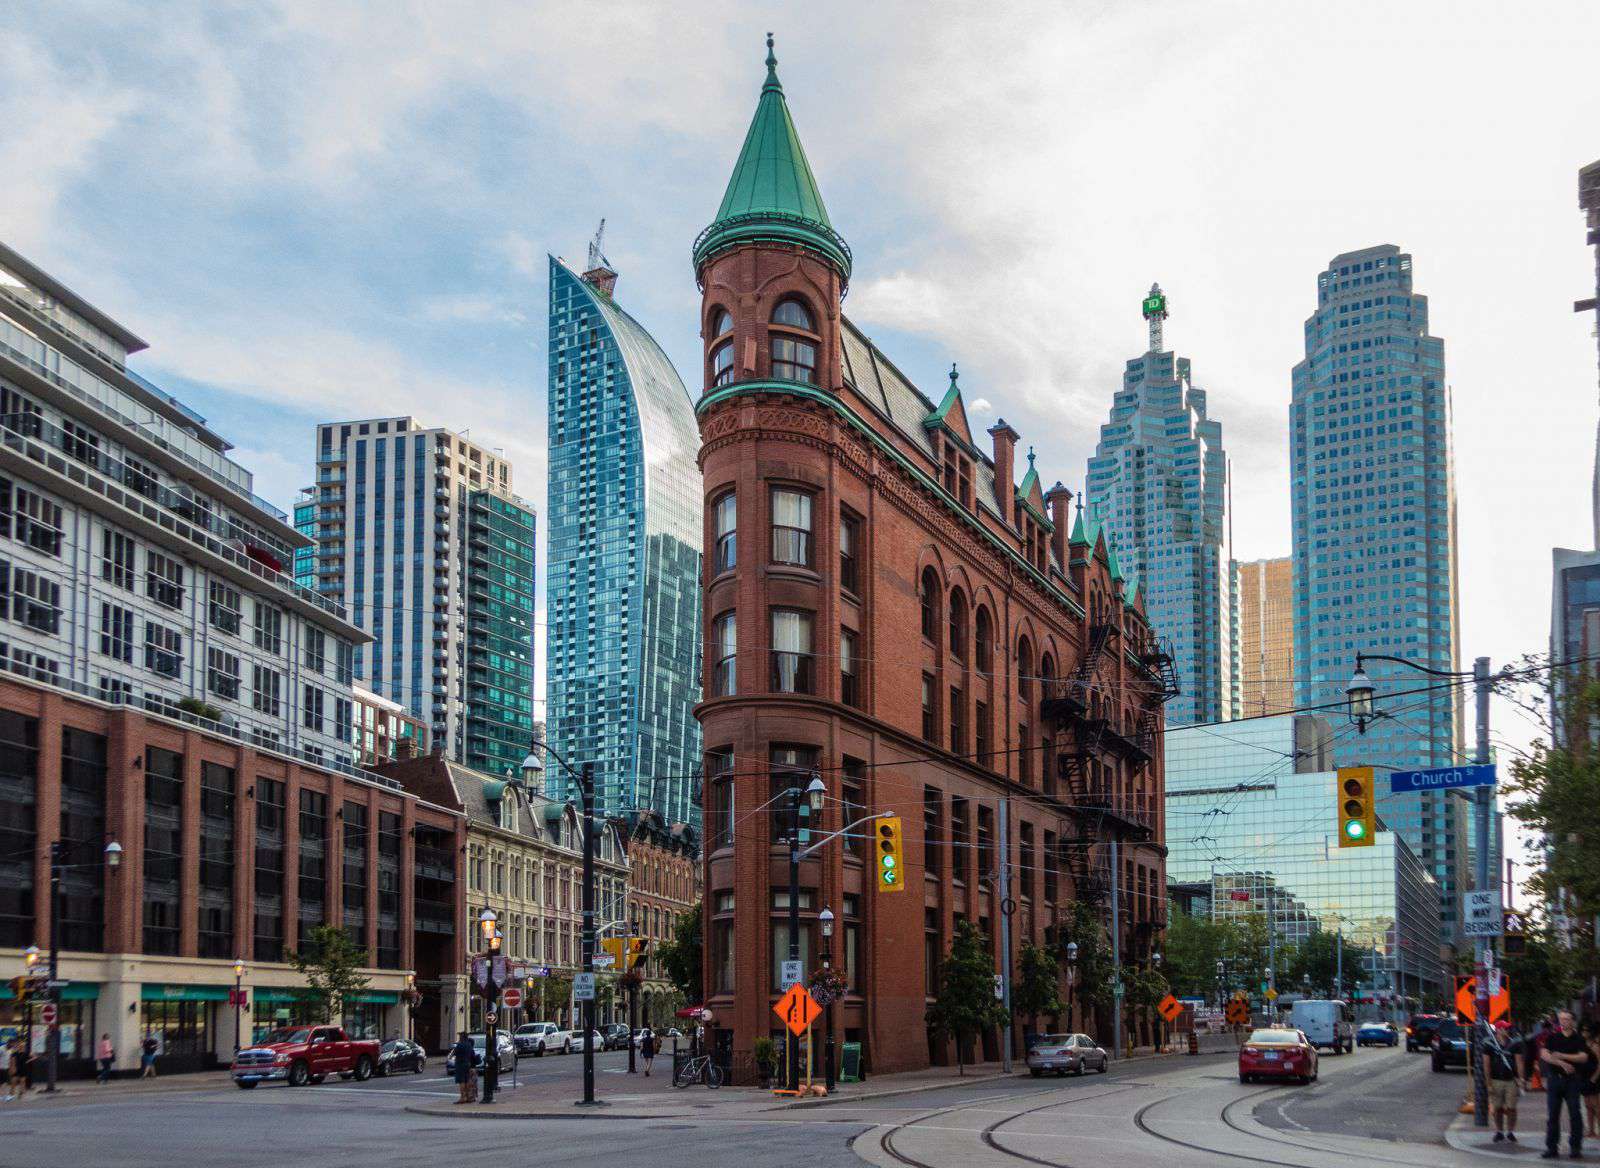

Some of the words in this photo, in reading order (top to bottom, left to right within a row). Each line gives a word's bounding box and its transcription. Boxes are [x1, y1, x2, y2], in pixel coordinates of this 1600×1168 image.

[1146, 299, 1160, 309] TD
[1411, 768, 1463, 786] Church
[1472, 893, 1491, 904] ONE
[1472, 907, 1491, 918] WAY
[1464, 920, 1501, 933] BEGINS
[581, 975, 589, 983] NO
